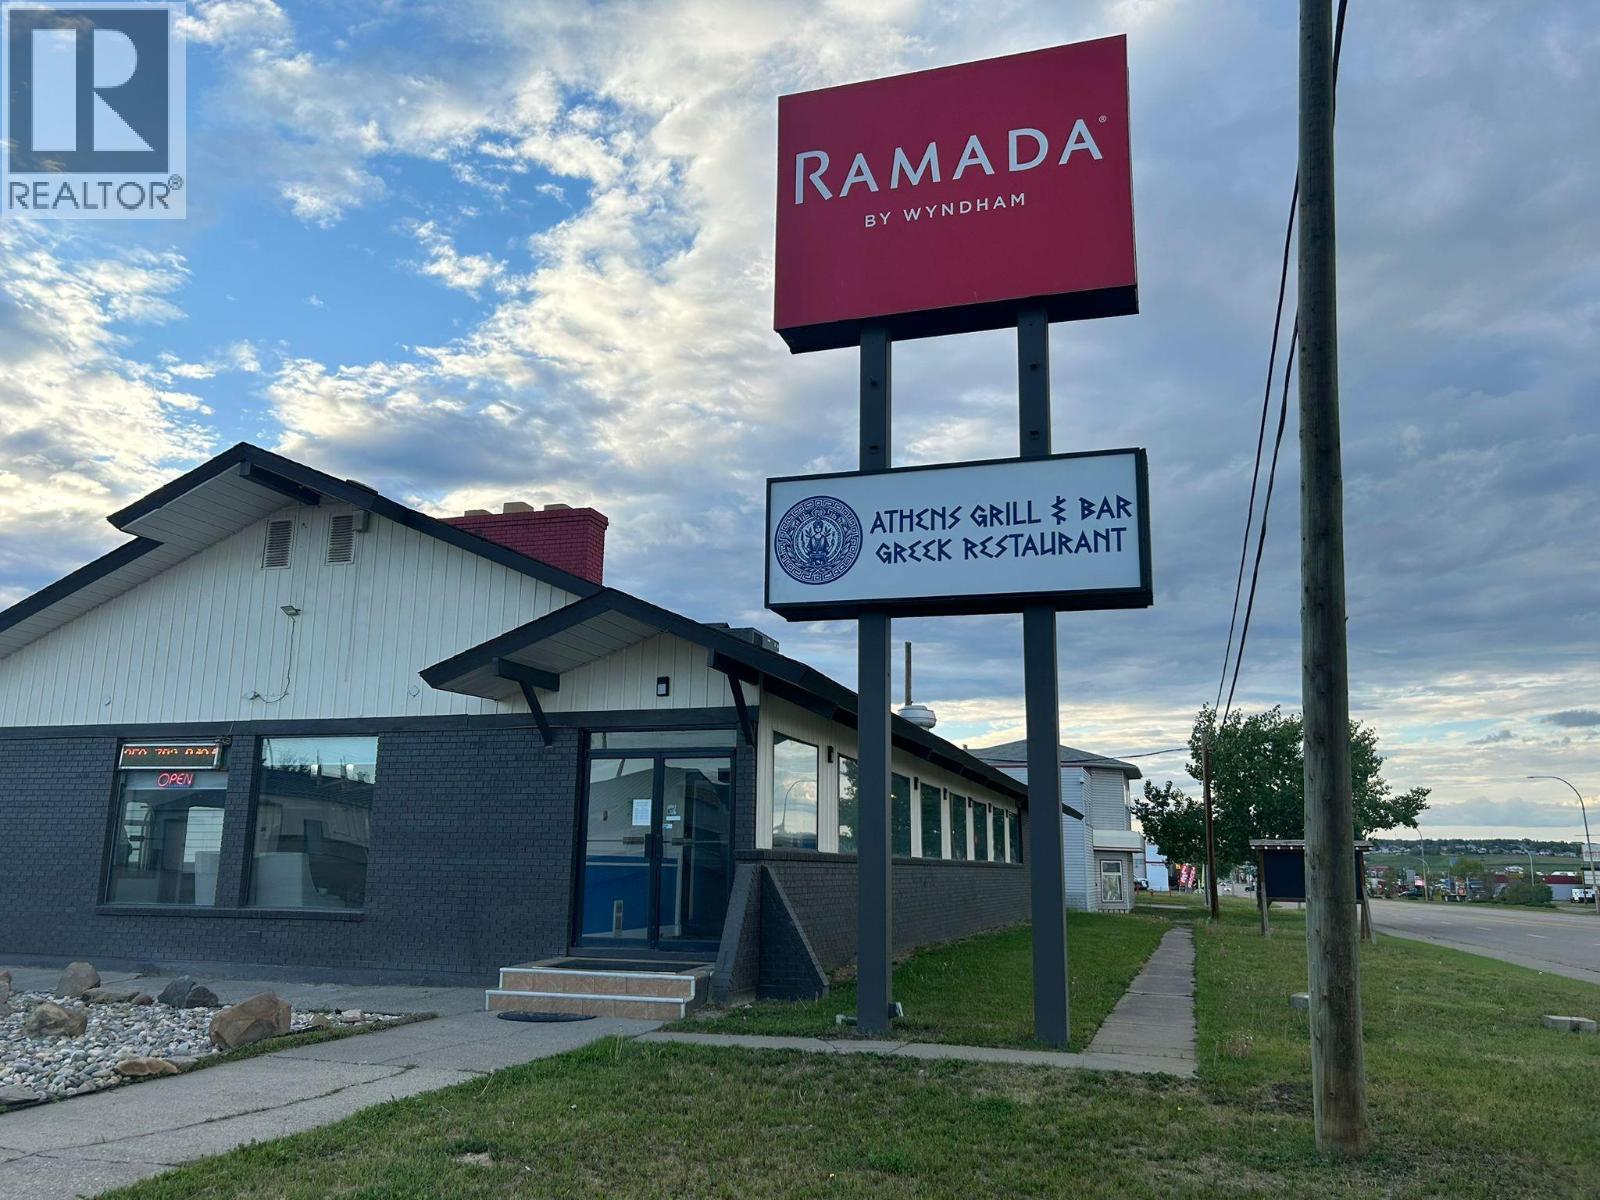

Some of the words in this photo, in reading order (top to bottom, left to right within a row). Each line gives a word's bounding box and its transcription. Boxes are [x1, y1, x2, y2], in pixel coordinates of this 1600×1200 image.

[864, 211, 891, 228] BY
[903, 193, 1026, 222] WYNDHAM
[869, 505, 963, 534] ATHENS
[970, 499, 1041, 528] GRILL
[1050, 495, 1067, 526] &
[1078, 494, 1133, 522] BAR
[875, 537, 953, 565] GREEK
[962, 527, 1127, 561] RESTAURANT
[157, 772, 194, 787] OPEN
